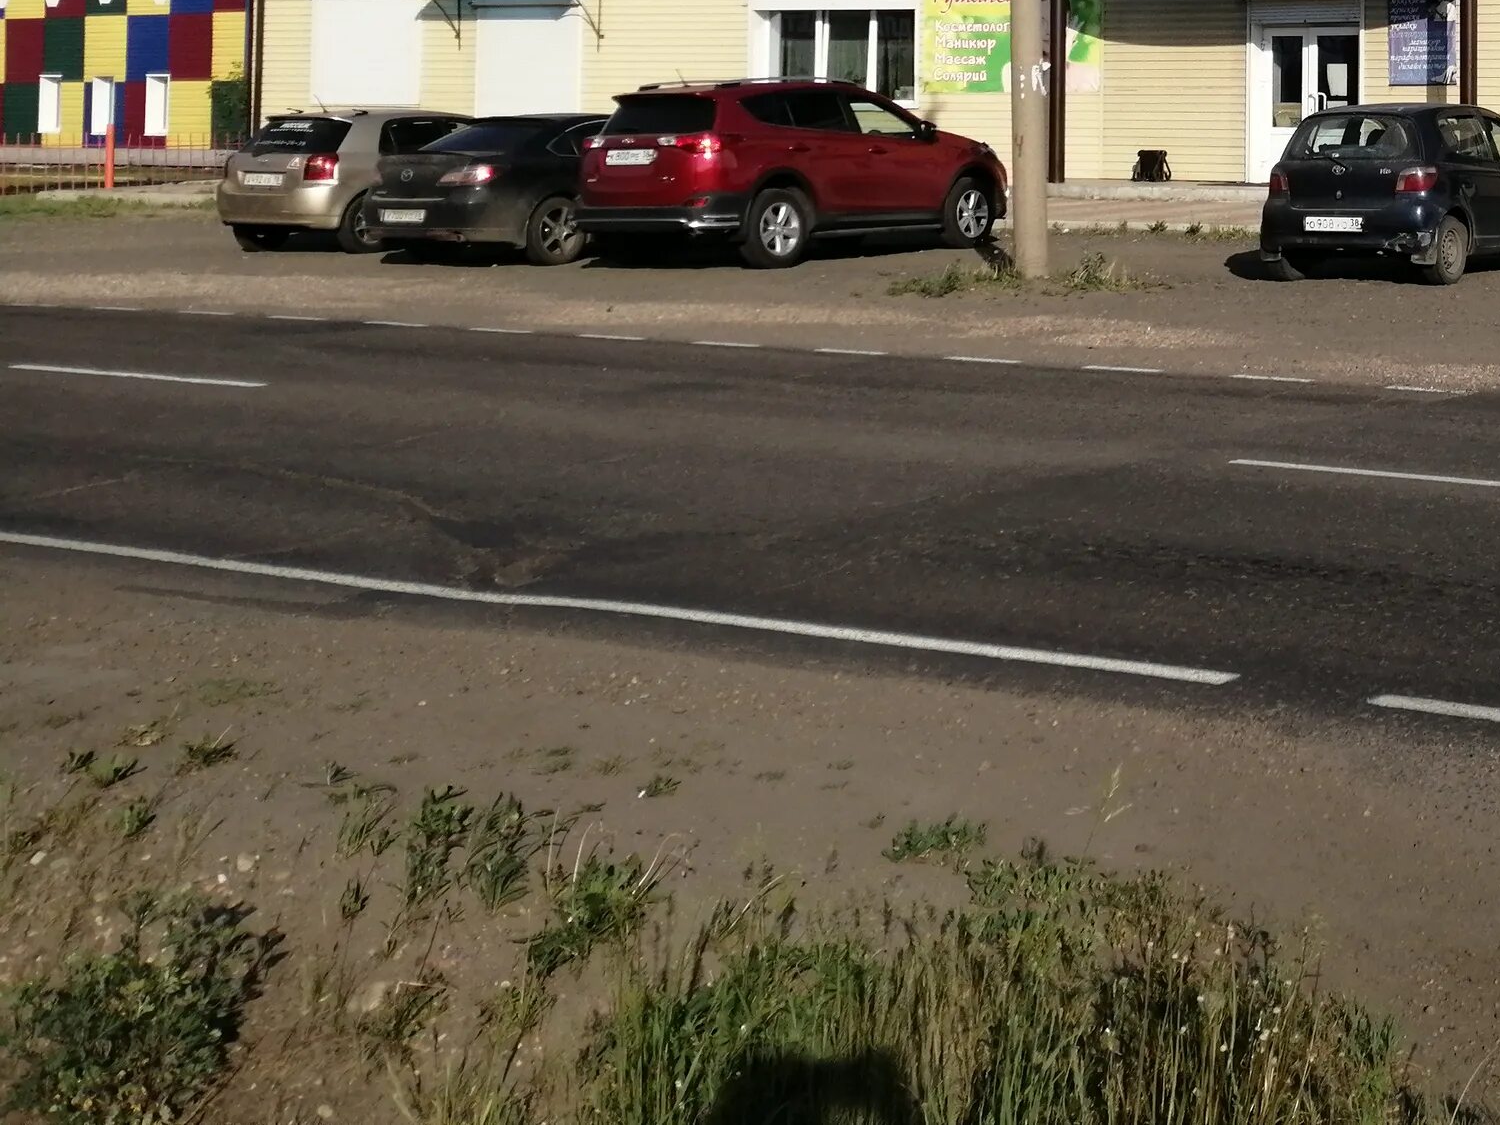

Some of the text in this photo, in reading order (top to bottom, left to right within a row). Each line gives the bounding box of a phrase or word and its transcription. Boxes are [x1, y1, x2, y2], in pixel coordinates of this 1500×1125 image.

[935, 35, 997, 55] Маникюр
[934, 51, 986, 65] Массаж
[934, 66, 988, 87] Солярий
